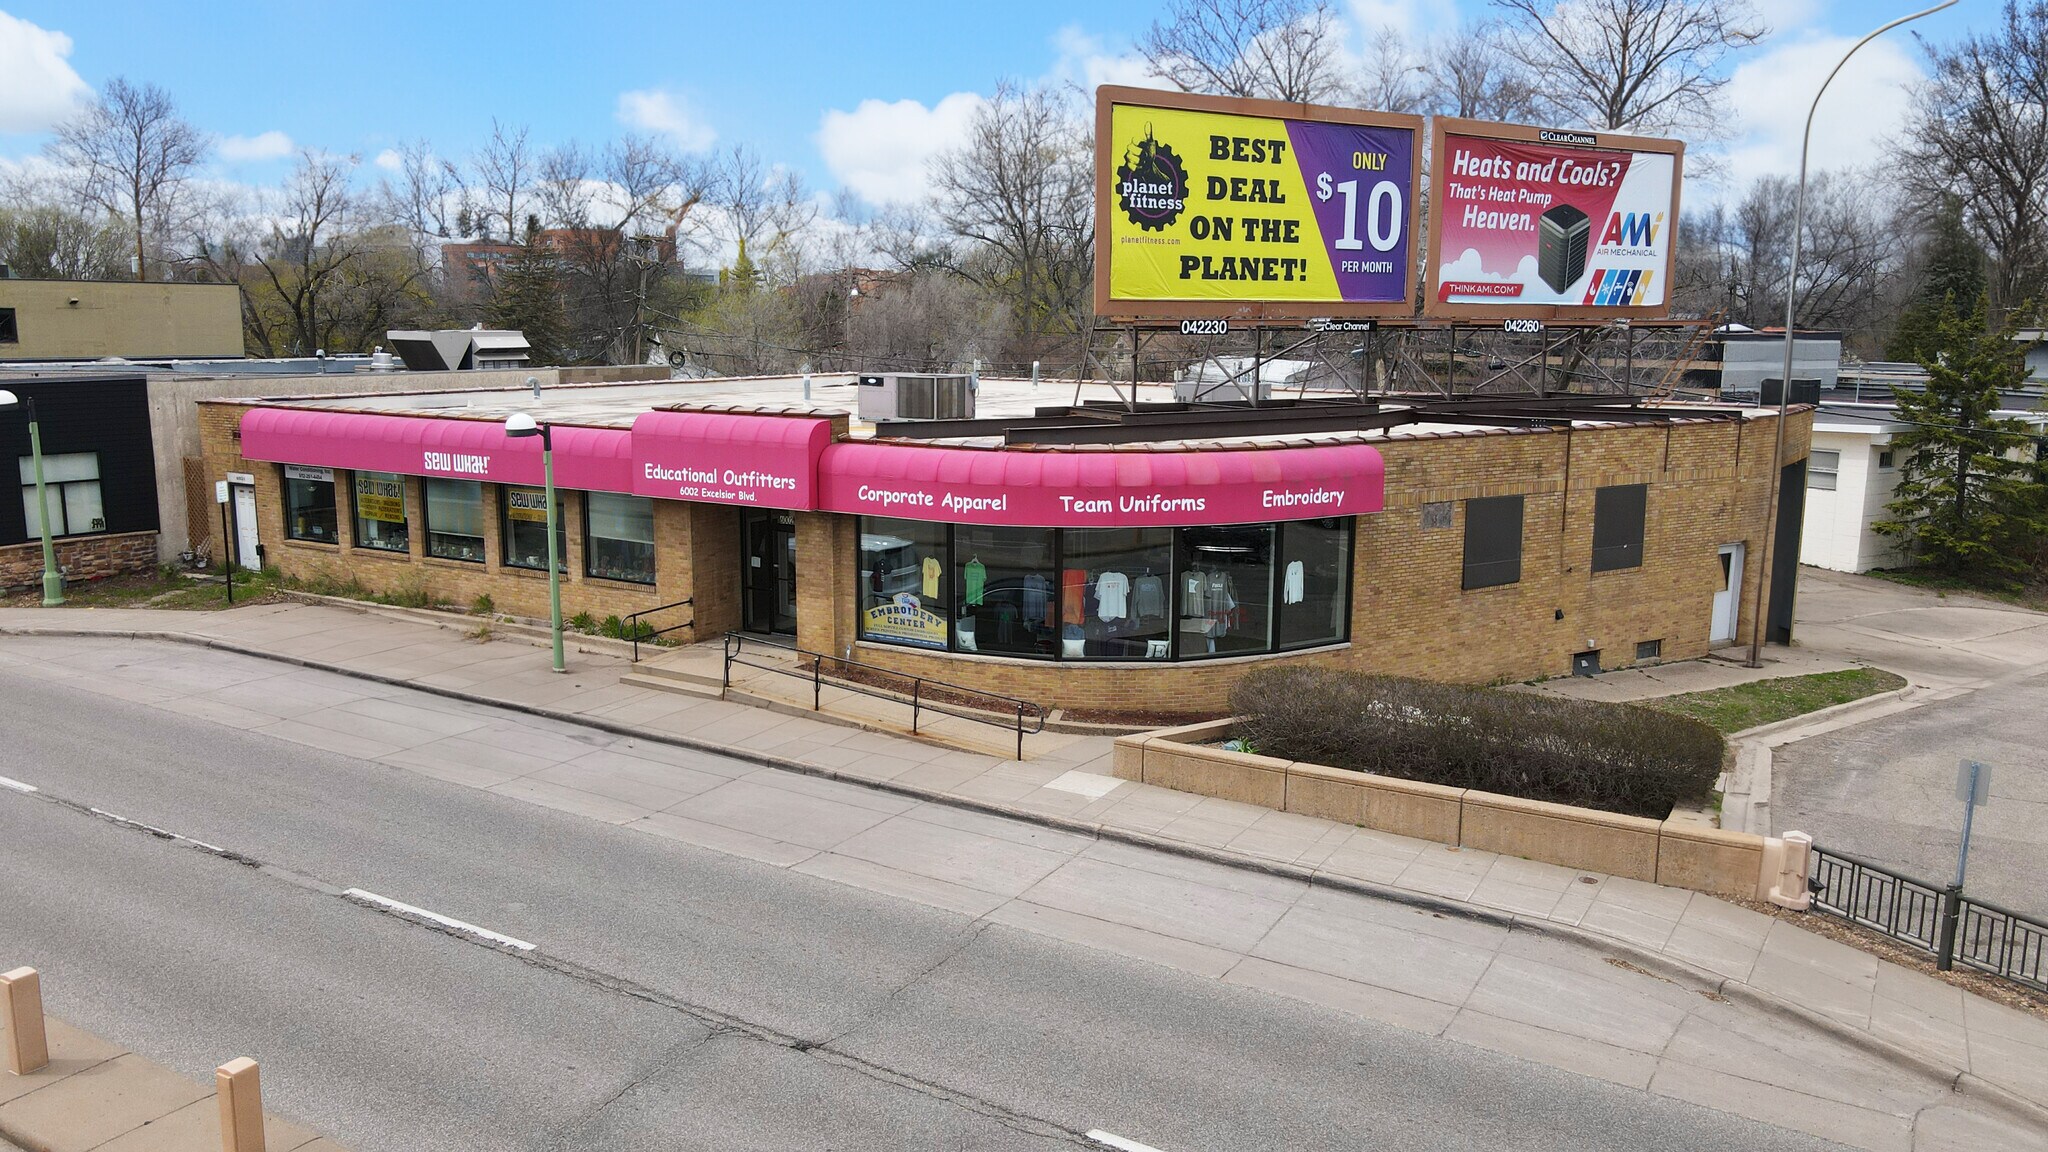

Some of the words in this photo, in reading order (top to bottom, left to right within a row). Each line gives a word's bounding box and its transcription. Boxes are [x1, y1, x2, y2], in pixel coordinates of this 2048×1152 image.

[1209, 135, 1286, 164] BEST
[1352, 152, 1387, 171] ONLY
[1452, 150, 1511, 180] Heats
[1516, 158, 1556, 183] and
[1558, 159, 1621, 188] Cools?
[1122, 178, 1173, 196] planet
[1206, 176, 1285, 204] DEAL
[1449, 183, 1486, 200] That's
[1488, 186, 1516, 202] Heat
[1518, 190, 1552, 208] Pump
[1130, 194, 1182, 210] fitness
[1316, 172, 1402, 252] $10
[1462, 204, 1535, 232] Heaven.
[1190, 216, 1234, 242] ON
[1242, 220, 1300, 243] THE
[1121, 236, 1180, 245] planetfitness.com
[1179, 256, 1307, 282] PLANET!
[1342, 261, 1359, 273] PER
[1361, 261, 1393, 273] MONTH
[1181, 321, 1228, 334] 042230
[1325, 322, 1342, 330] Clear
[1344, 322, 1370, 330] Channel
[1504, 320, 1539, 332] 042260
[644, 463, 717, 484] Educational
[723, 469, 796, 490] Outfitters
[680, 487, 699, 497] 6002
[701, 488, 736, 500] Excelsior
[738, 491, 758, 502] Blvd.
[858, 485, 934, 507] Corporate
[941, 492, 1007, 513] Apparel
[1059, 496, 1112, 513] Team
[1119, 494, 1206, 513] Uniforms
[1262, 488, 1345, 508] Embroidery
[870, 606, 942, 627] EMBROIDERY
[888, 617, 925, 628] CENTER
